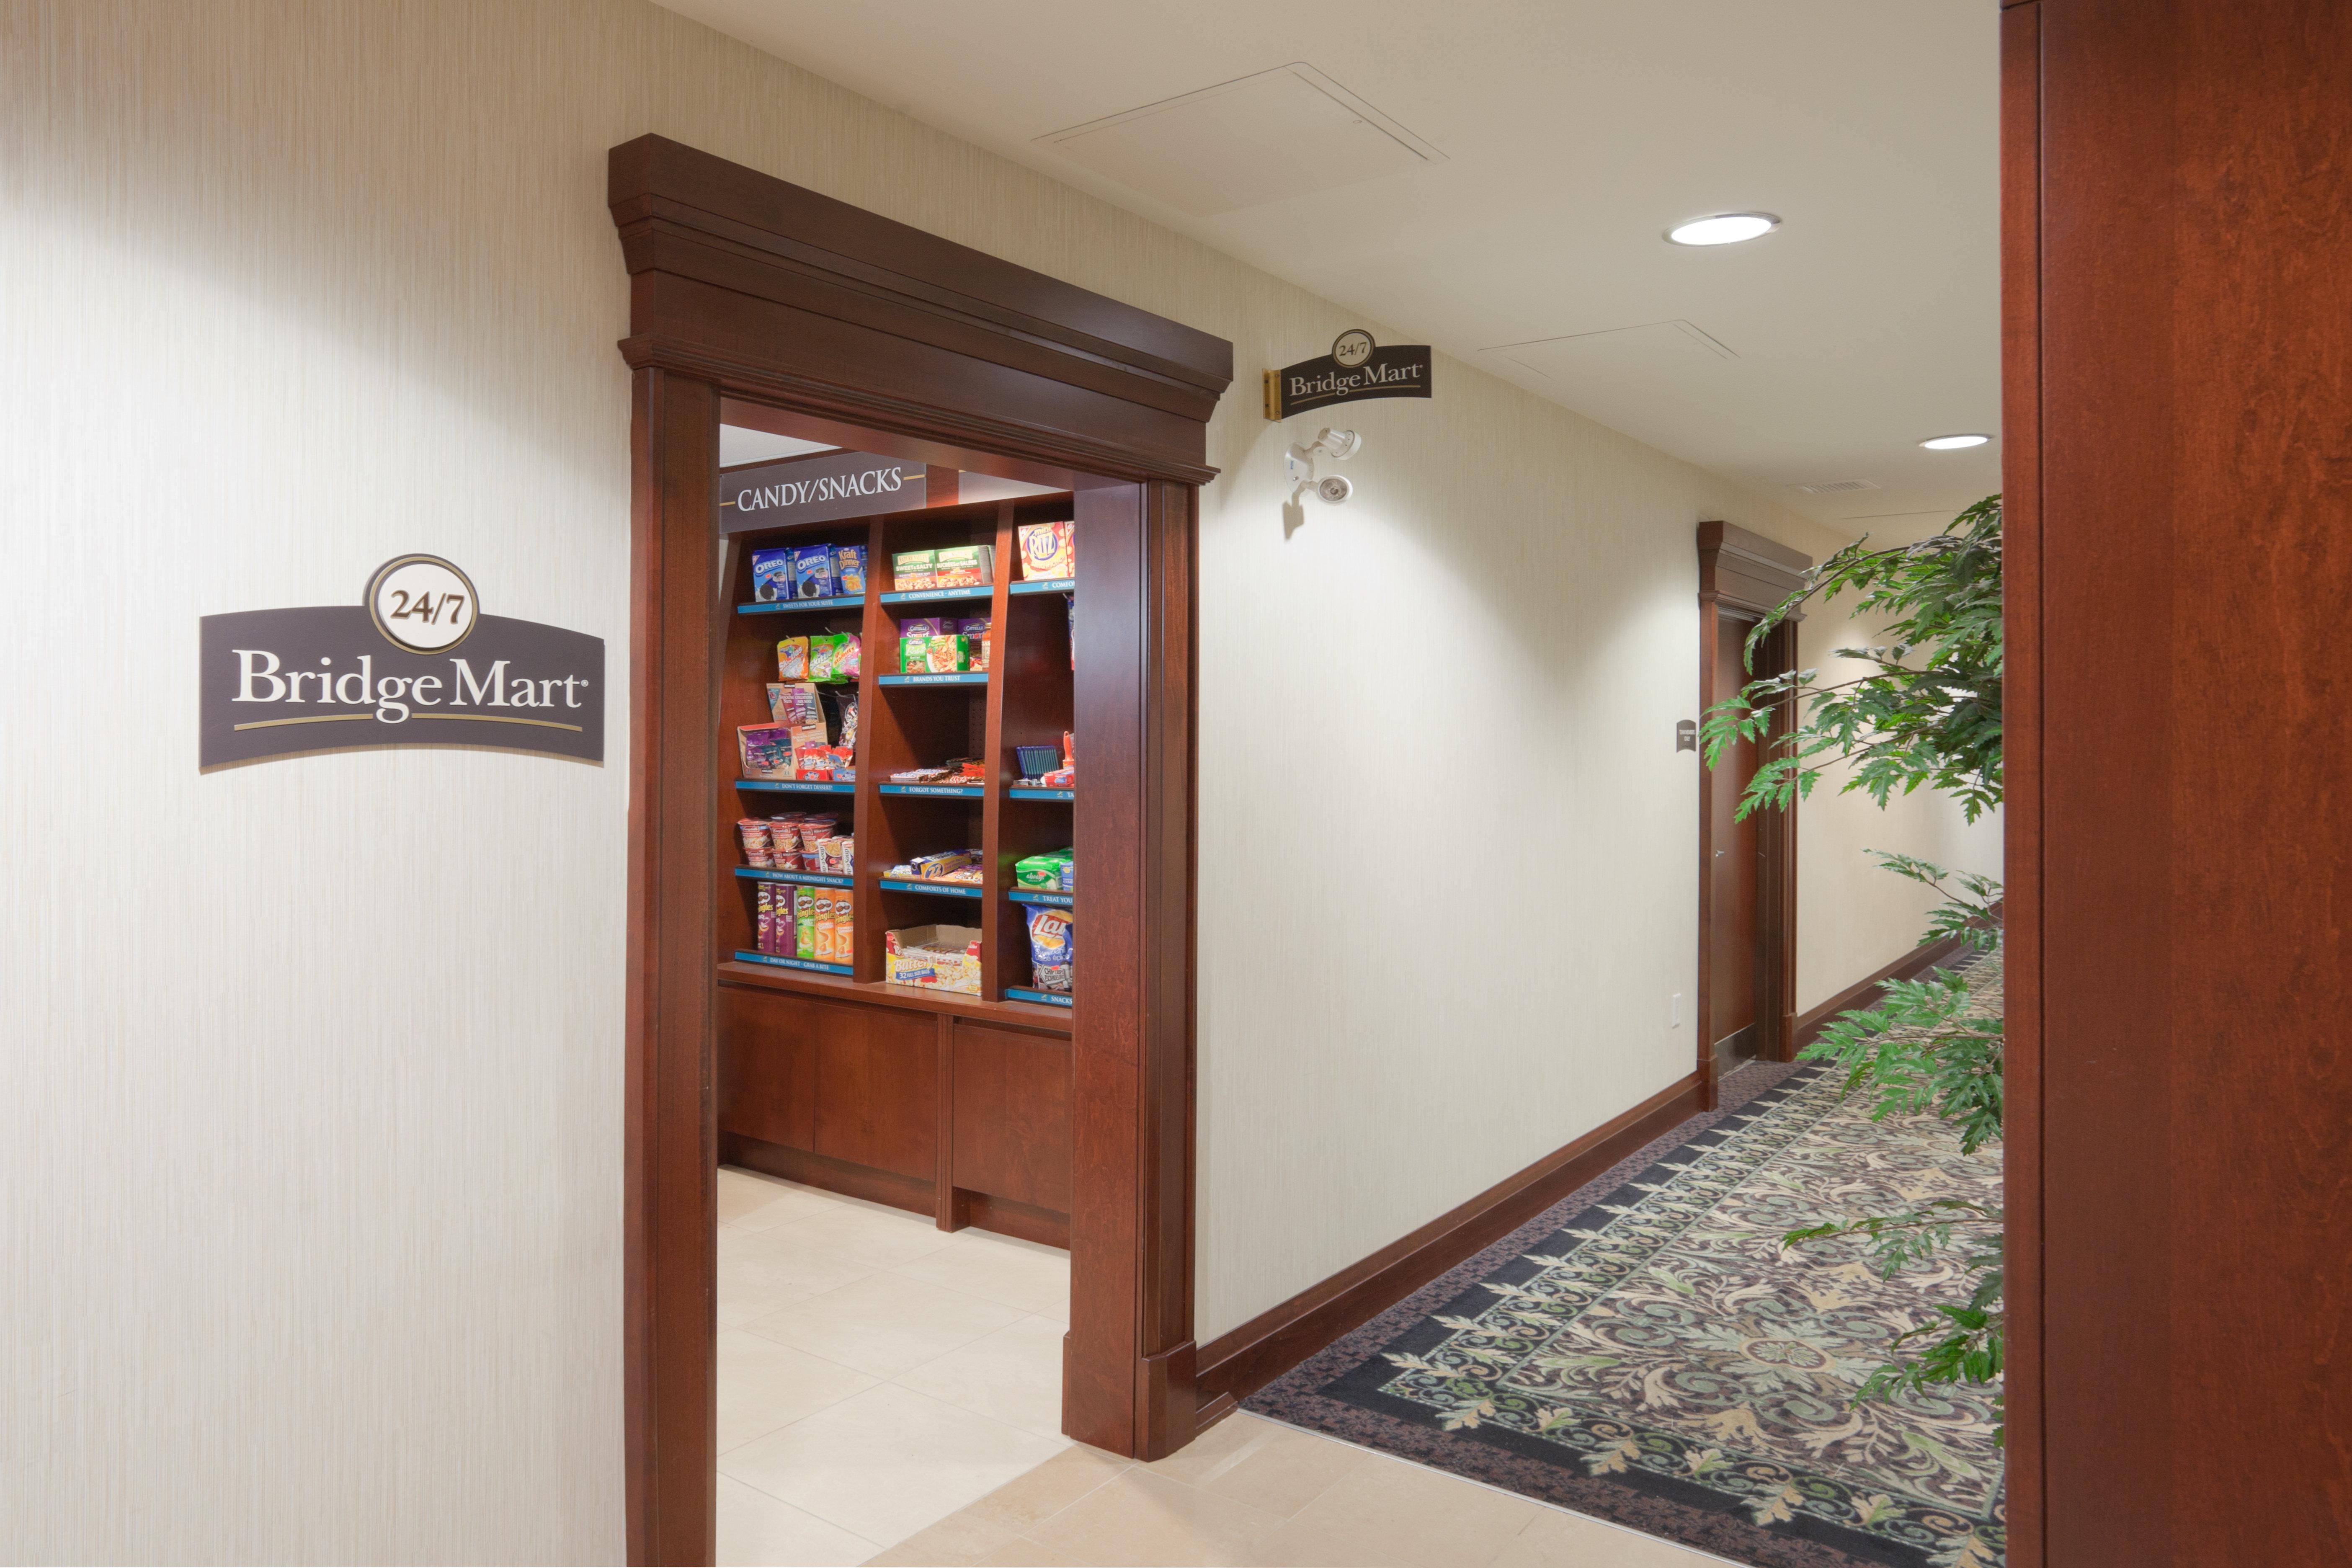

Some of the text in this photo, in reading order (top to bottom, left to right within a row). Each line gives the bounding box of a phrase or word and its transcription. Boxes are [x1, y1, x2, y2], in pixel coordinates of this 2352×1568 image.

[1339, 342, 1367, 356] 24/7
[738, 467, 901, 511] CANDY/SNACKS
[1029, 531, 1055, 556] RITZ
[838, 549, 857, 560] Kraft
[756, 559, 783, 574] OREO
[797, 555, 826, 570] OREO
[839, 560, 860, 570] Dinner
[391, 590, 465, 625] 24/7
